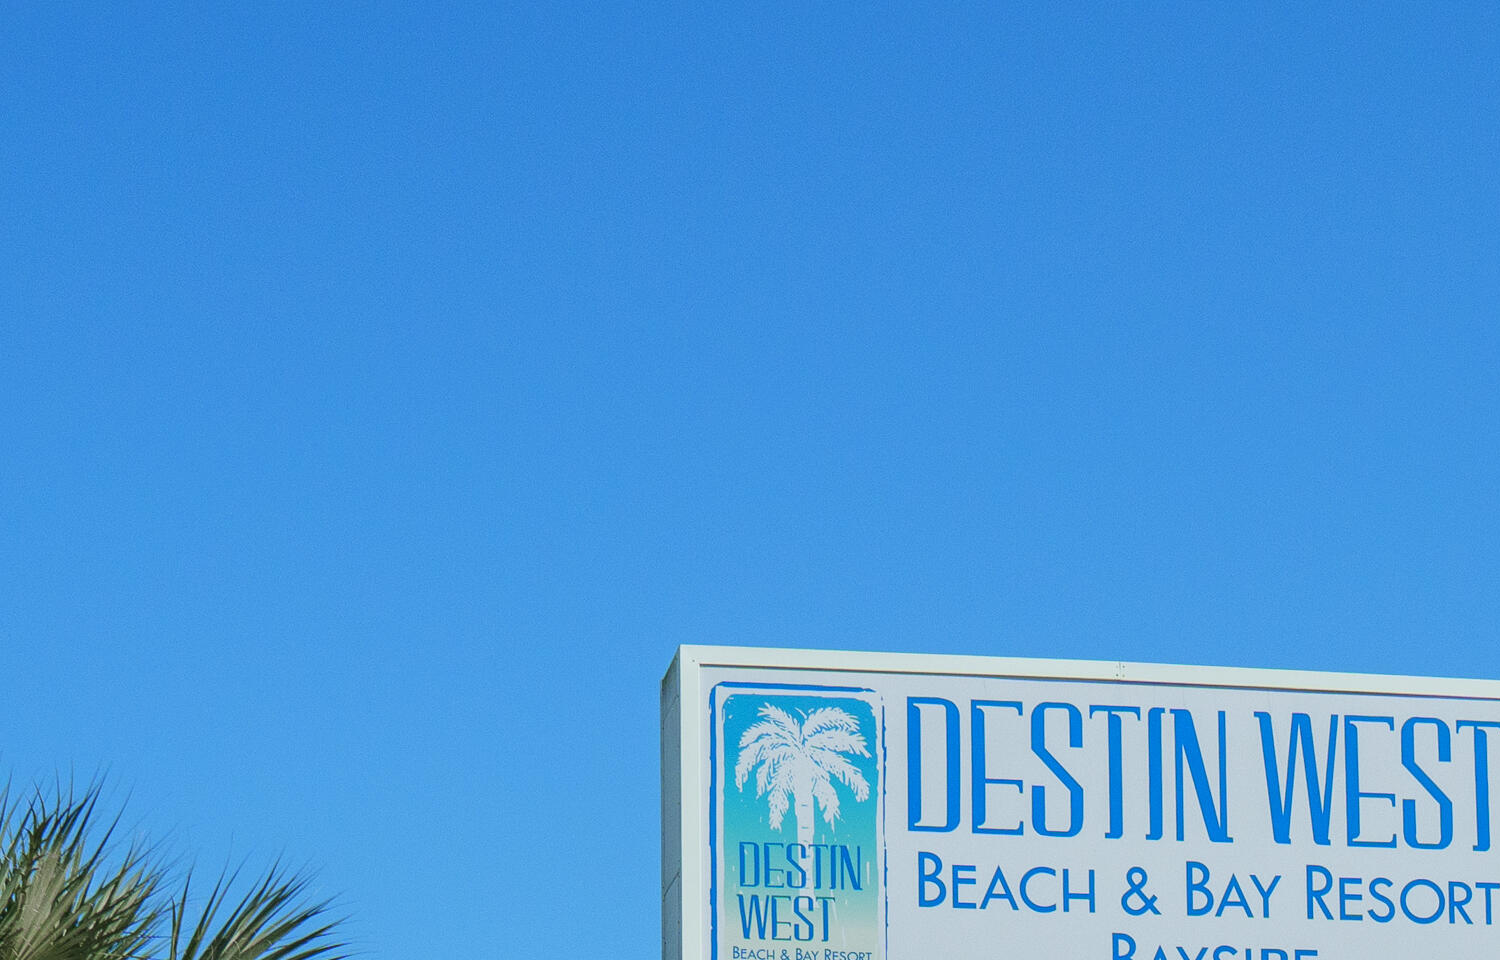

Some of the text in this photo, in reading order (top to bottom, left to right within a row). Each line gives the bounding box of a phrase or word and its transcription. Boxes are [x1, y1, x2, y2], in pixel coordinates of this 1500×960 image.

[906, 695, 1234, 843] DESTIN
[738, 841, 863, 891] DESTIN
[917, 851, 1096, 914] BEACH
[1120, 866, 1161, 917] &
[1185, 861, 1282, 920] BAY
[736, 893, 836, 942] WEST
[732, 945, 776, 960] BEACH
[779, 948, 791, 960] &
